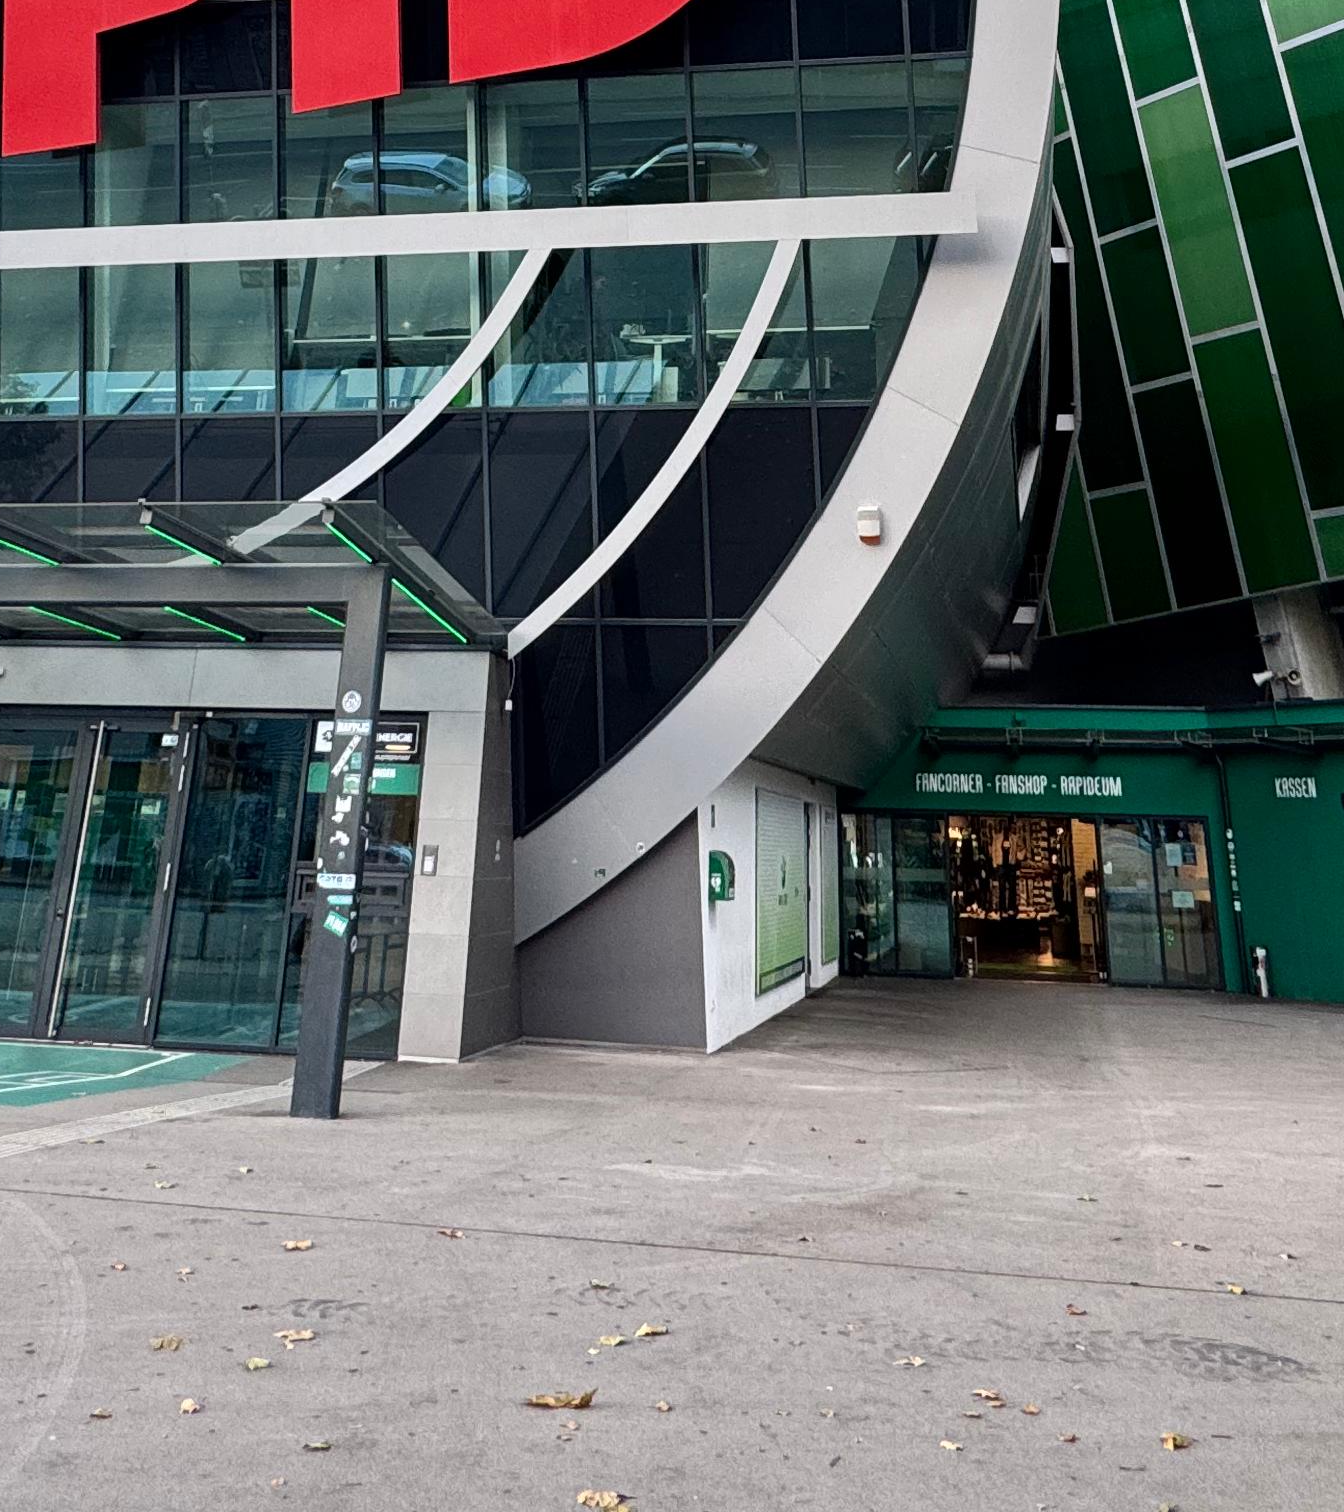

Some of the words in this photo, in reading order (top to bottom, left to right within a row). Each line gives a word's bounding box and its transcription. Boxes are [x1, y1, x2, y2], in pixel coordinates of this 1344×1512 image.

[915, 772, 983, 794] FANCORNER
[995, 774, 1048, 796] FANSHOP
[1060, 775, 1123, 797] RAPIDEUM
[1274, 777, 1317, 799] KASSEN
